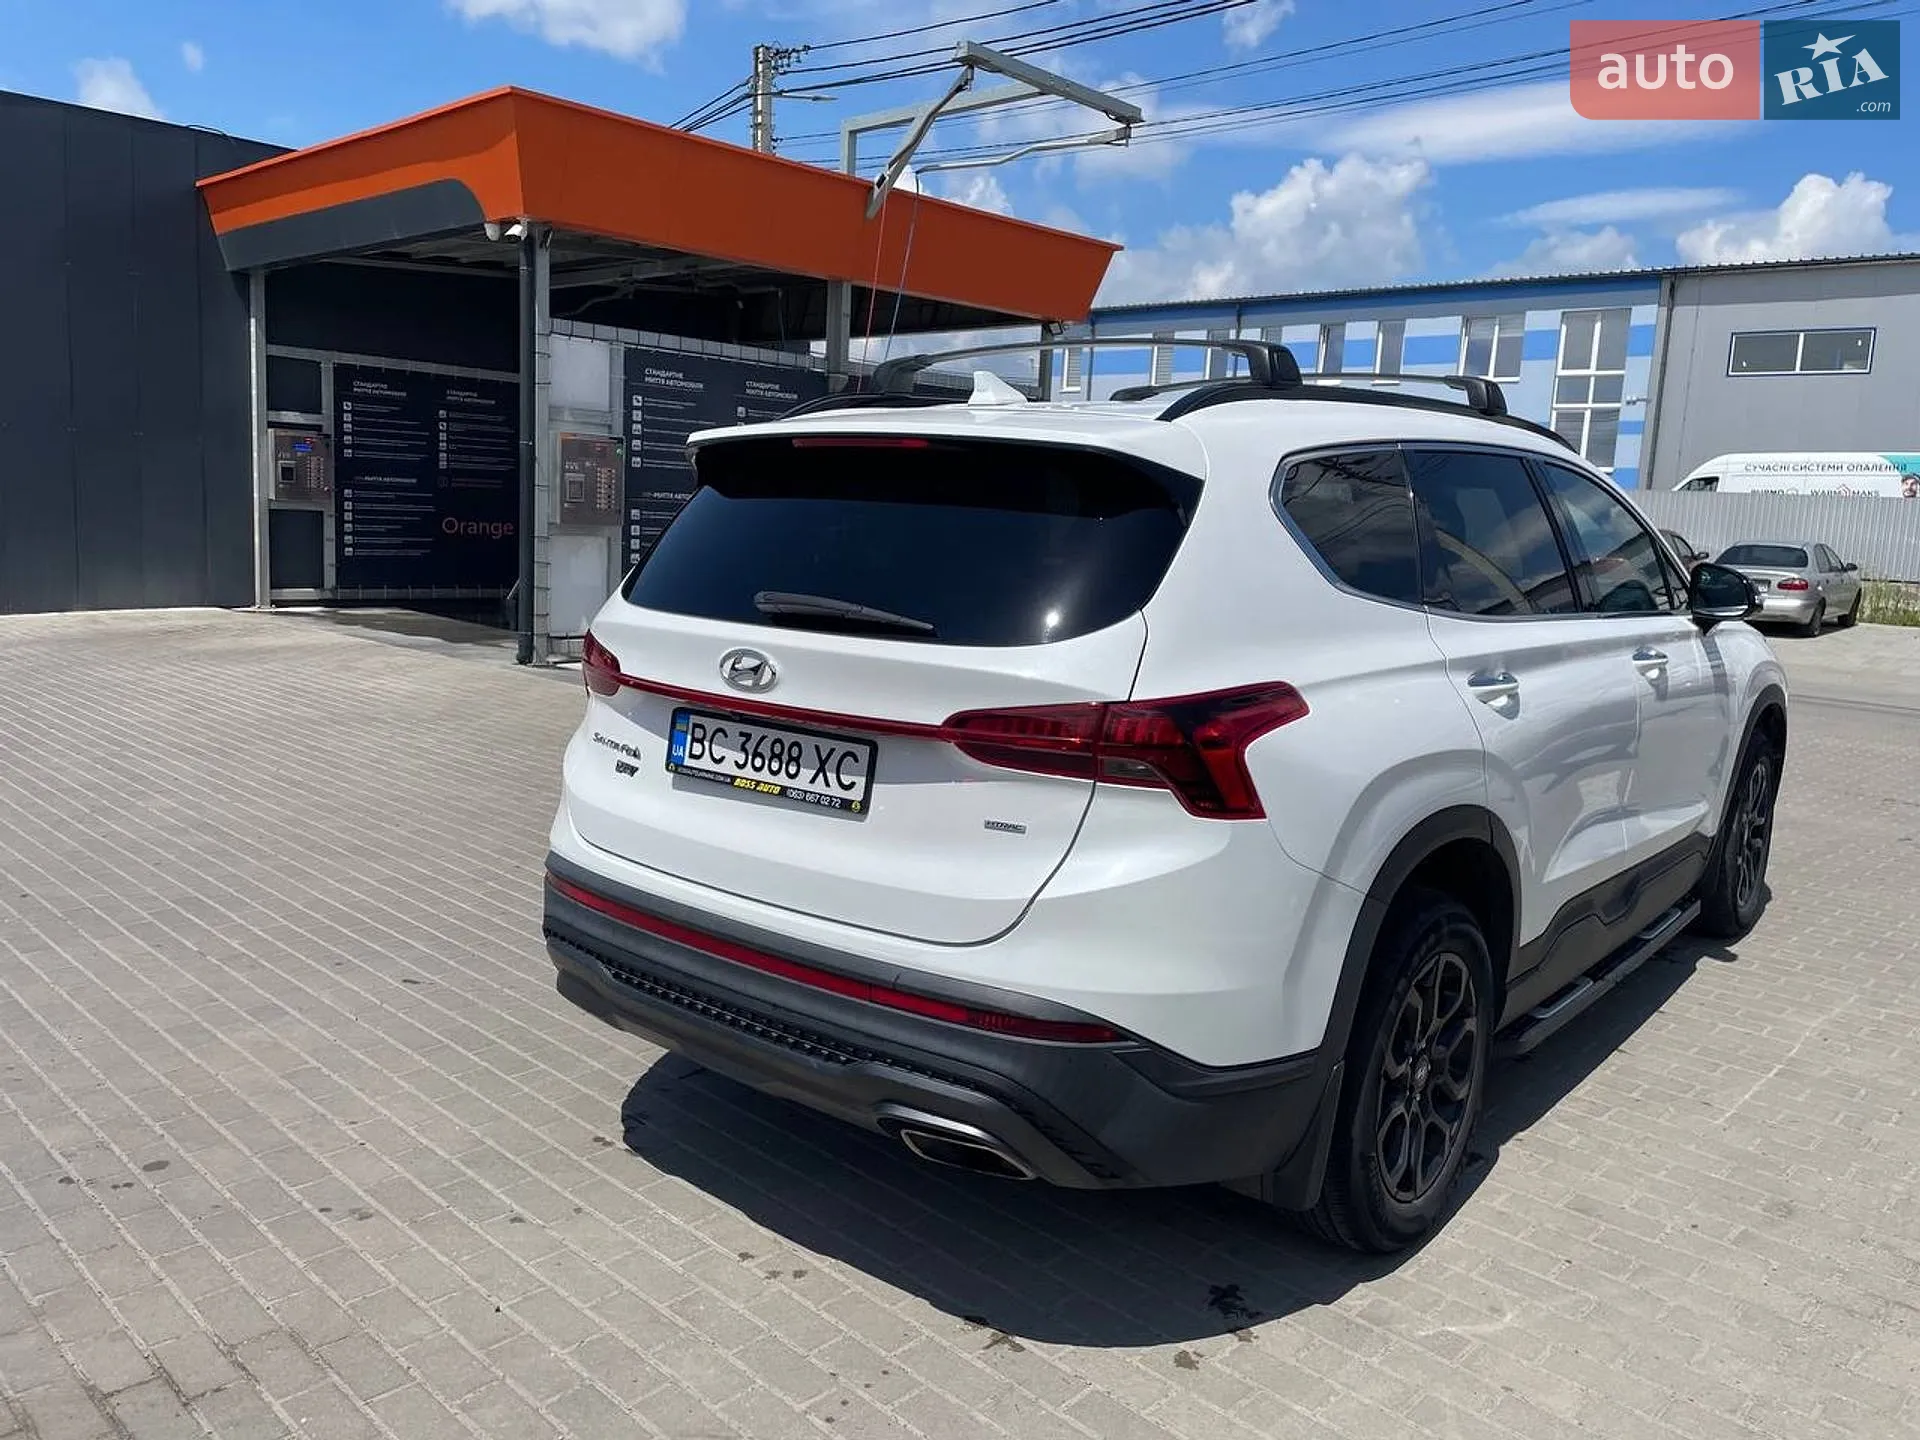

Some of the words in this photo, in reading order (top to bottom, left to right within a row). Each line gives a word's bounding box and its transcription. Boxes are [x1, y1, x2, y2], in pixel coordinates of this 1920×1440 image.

[1792, 464, 1843, 473] СИСТЕМИ
[442, 517, 514, 539] Orange
[673, 745, 683, 757] UA
[688, 723, 729, 764] BC
[734, 731, 802, 779] 3688
[809, 744, 859, 791] XC
[733, 778, 755, 791] BOSS
[756, 783, 782, 796] AUTO
